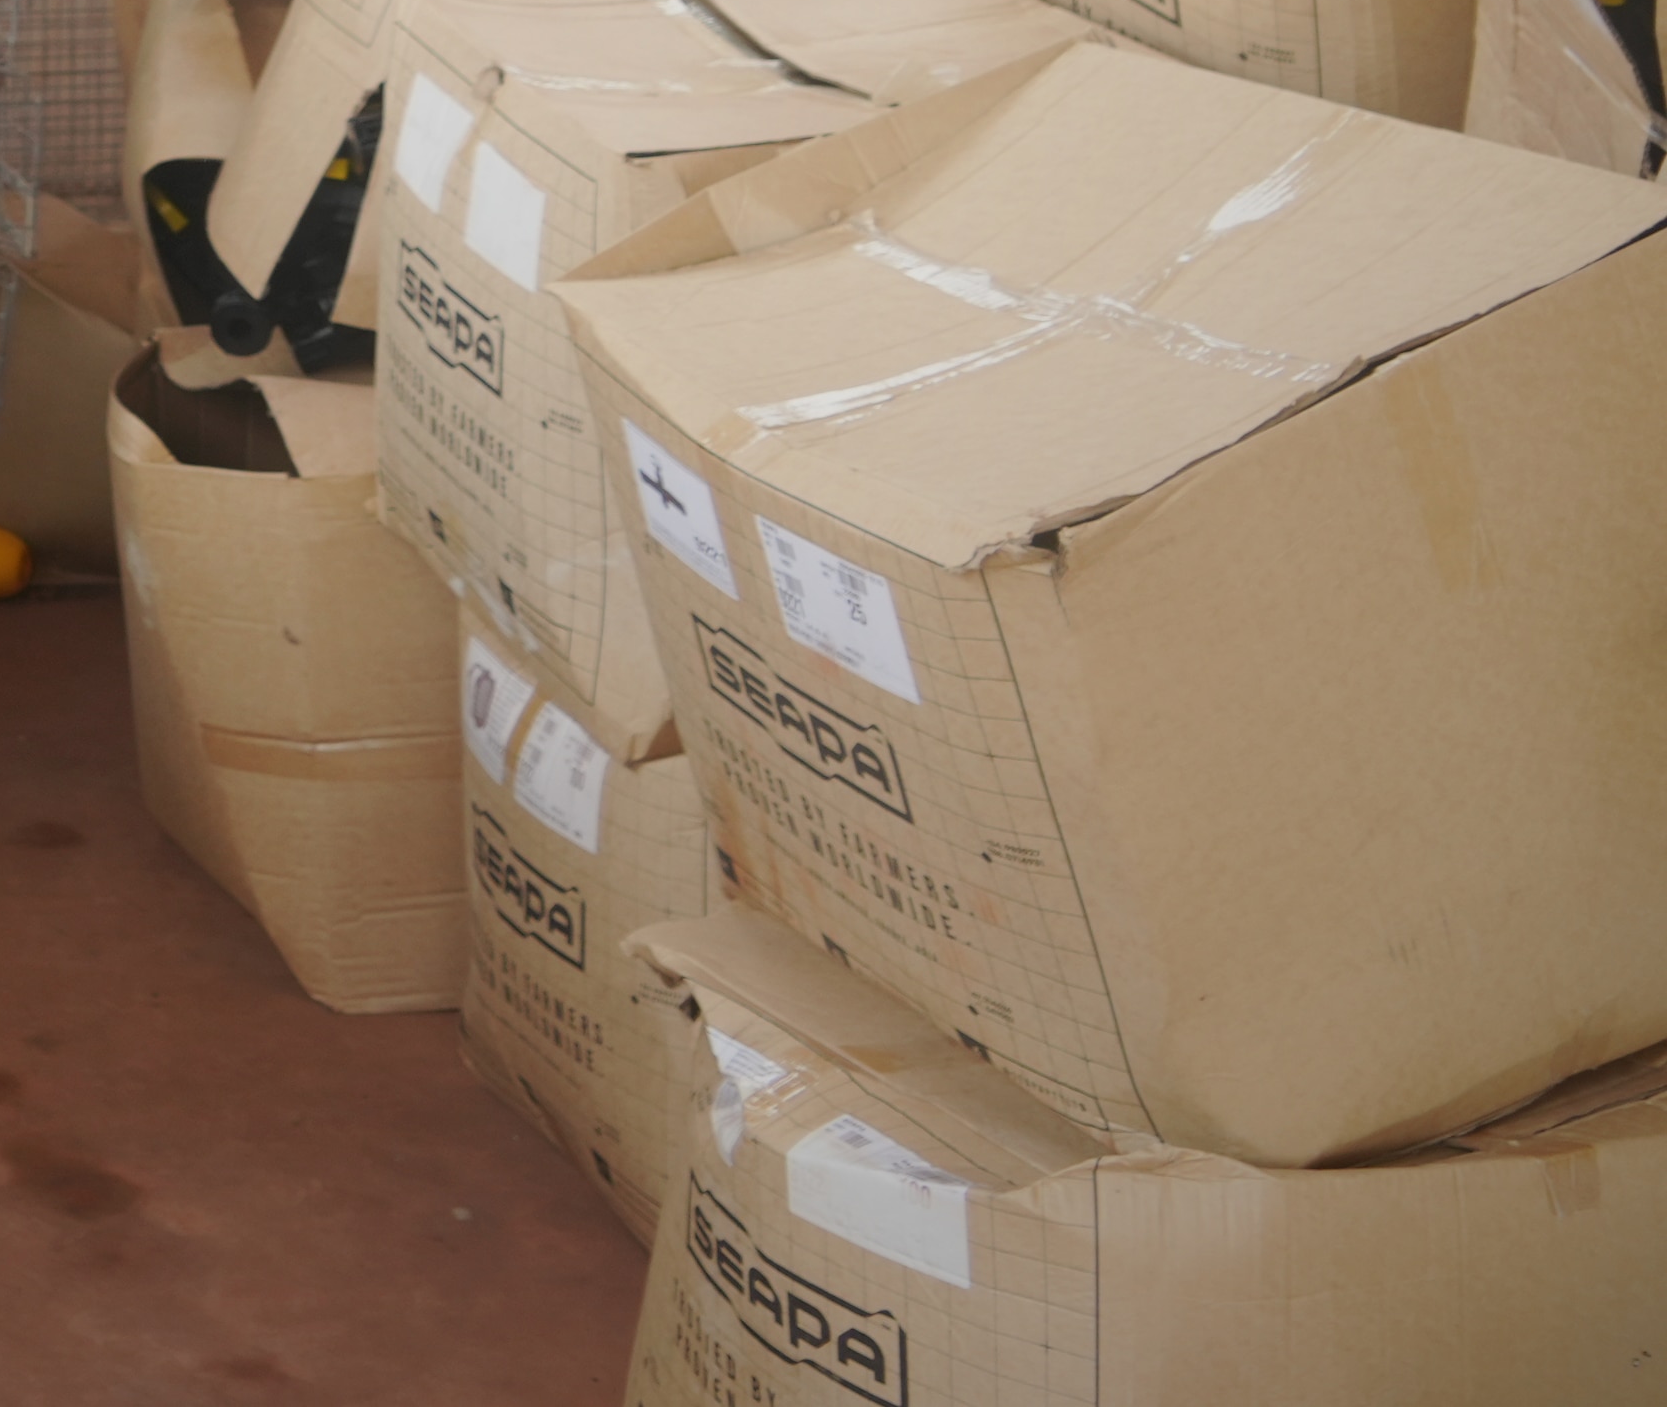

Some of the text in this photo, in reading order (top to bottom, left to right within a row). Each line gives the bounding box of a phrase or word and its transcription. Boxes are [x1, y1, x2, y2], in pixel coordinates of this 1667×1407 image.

[402, 263, 496, 373] SEAPA
[710, 644, 891, 794] SEAPA
[474, 825, 573, 946] SEAPA
[695, 1205, 885, 1383] SEAPA
